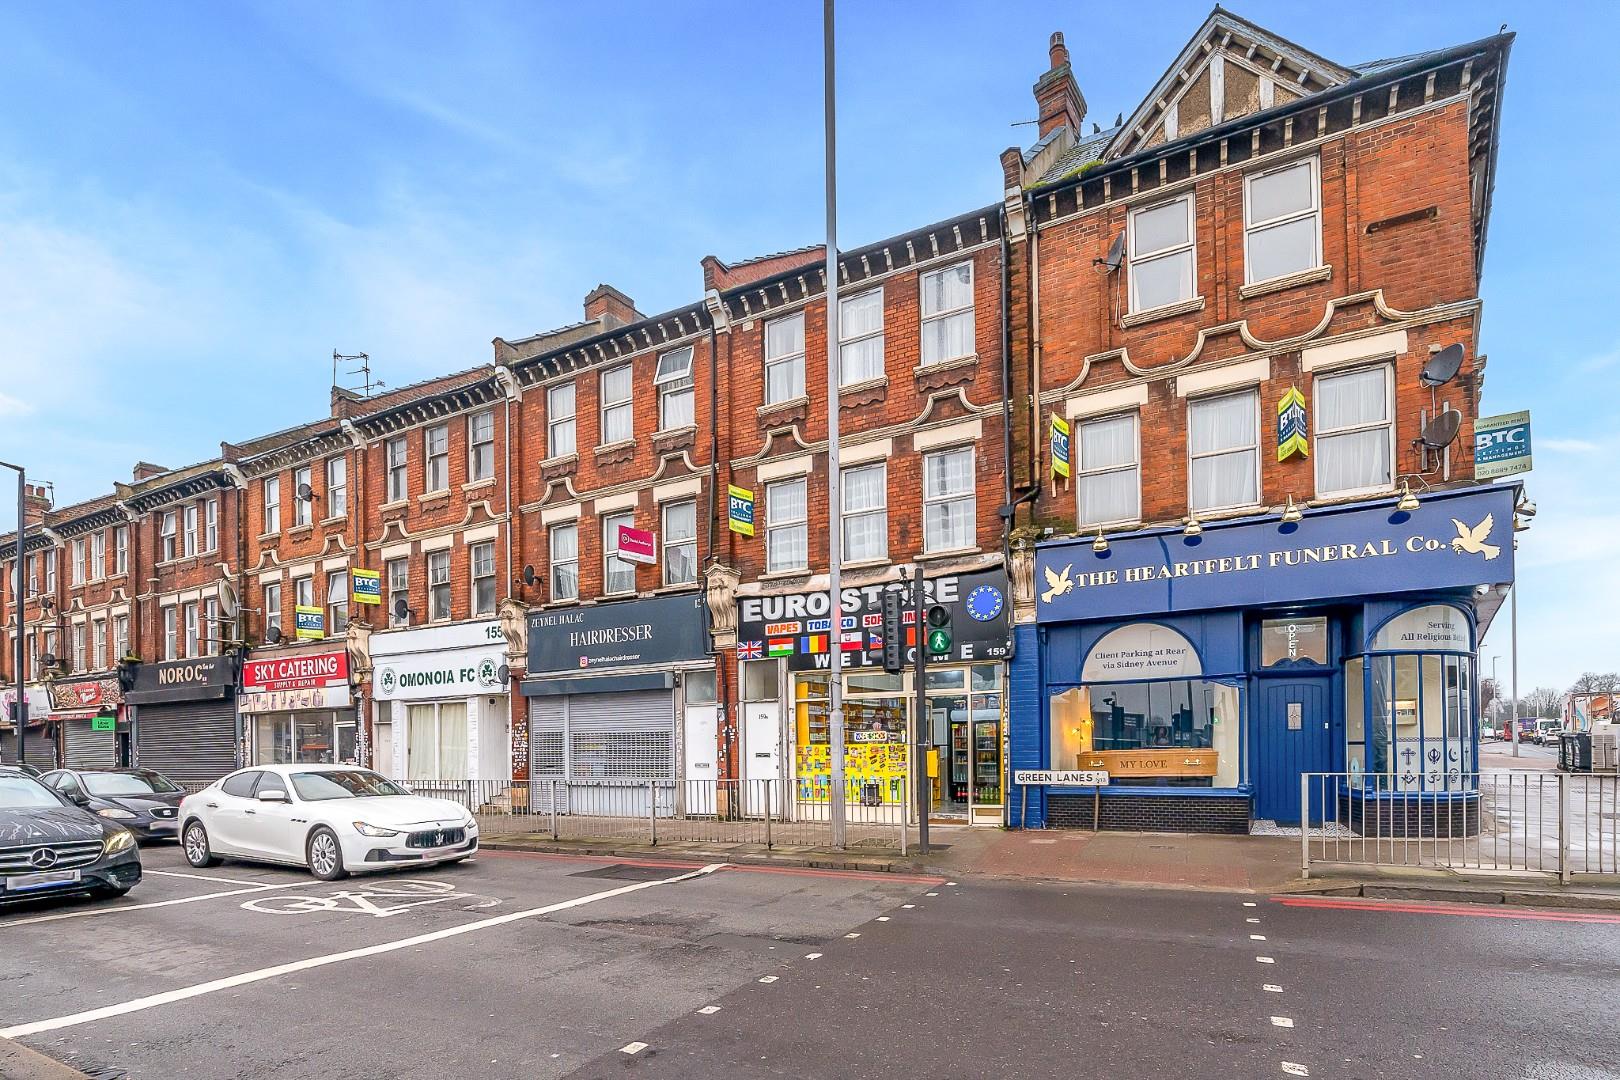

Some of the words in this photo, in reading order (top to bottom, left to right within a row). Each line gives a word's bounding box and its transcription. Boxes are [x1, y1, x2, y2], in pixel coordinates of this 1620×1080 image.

[1053, 428, 1067, 450] BTC
[1477, 428, 1525, 450] BTC
[731, 496, 751, 514] BTC
[1075, 570, 1119, 588] THE
[1125, 554, 1262, 583] HEARTFELT
[1269, 540, 1398, 567] FUNERAL
[1406, 536, 1447, 552] Co.
[355, 577, 378, 588] BTC
[298, 613, 322, 624] BTC
[531, 615, 558, 628] ZEYNEL
[559, 612, 584, 625] HALAC
[767, 623, 798, 634] VAPES
[1427, 621, 1455, 630] Serving
[570, 624, 653, 647] HAIRDRESSER
[1288, 624, 1296, 657] OPEN
[1401, 633, 1414, 641] All
[1417, 632, 1451, 643] Religious
[986, 647, 1006, 656] 159
[1095, 651, 1119, 660] Client
[1121, 649, 1153, 658] Parking
[255, 663, 275, 681] SKY
[279, 656, 338, 678] CATERING
[1103, 661, 1115, 669] via
[1117, 660, 1144, 669] Sidney
[1146, 659, 1178, 667] Avenue
[159, 664, 203, 685] NOROC
[400, 670, 455, 687] OMONOIA
[460, 668, 475, 682] FC
[274, 681, 291, 689] SUPPLY
[297, 679, 316, 687] REPAIR
[1120, 760, 1137, 768] MY
[1140, 759, 1168, 768] LOVE
[1018, 773, 1051, 782] GREEN
[1057, 773, 1093, 782] LANES
